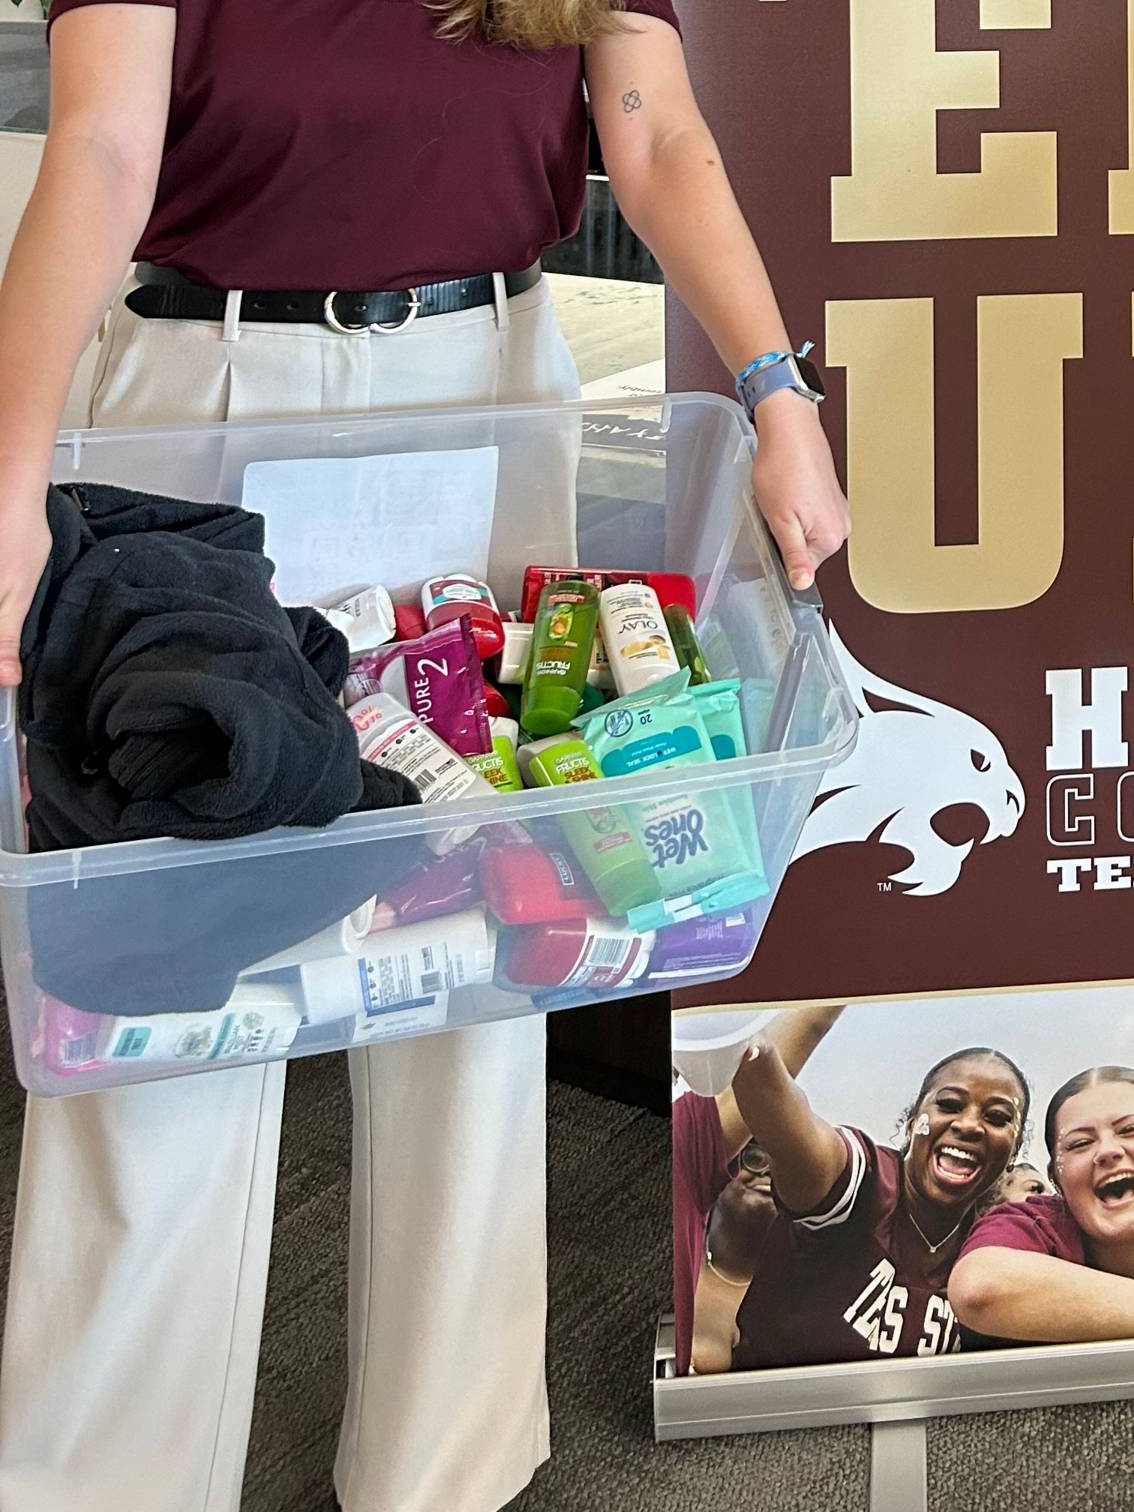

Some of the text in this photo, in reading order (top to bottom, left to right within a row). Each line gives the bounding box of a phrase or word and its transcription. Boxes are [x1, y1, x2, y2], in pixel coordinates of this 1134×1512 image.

[618, 620, 658, 635] OLAY
[414, 658, 449, 724] PURE 2
[639, 714, 653, 726] 20
[643, 809, 704, 846] Ones
[651, 832, 709, 869] Wet
[876, 882, 892, 892] TM
[916, 1294, 962, 1357] ST
